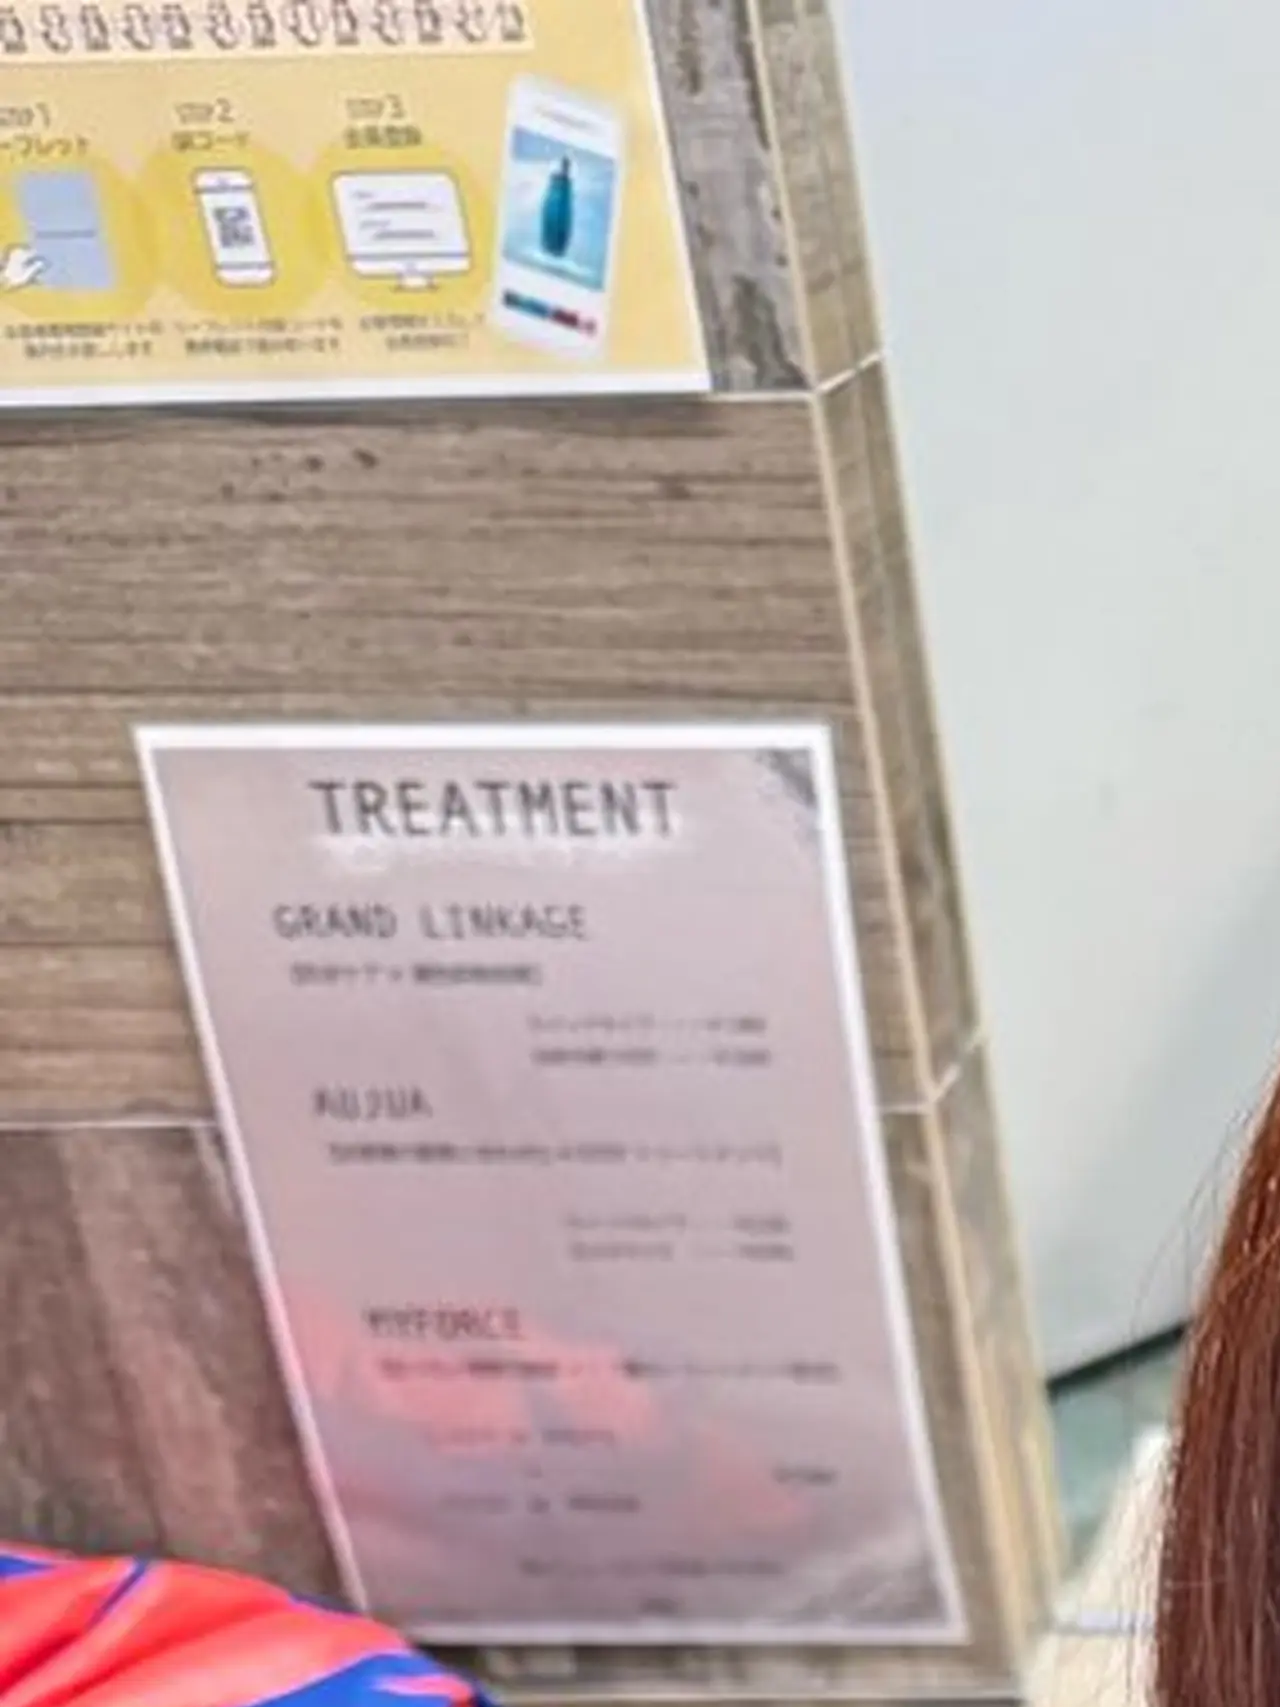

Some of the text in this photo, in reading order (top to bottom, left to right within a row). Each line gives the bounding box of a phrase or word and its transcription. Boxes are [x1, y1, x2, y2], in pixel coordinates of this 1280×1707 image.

[308, 780, 678, 838] TREATMENT
[272, 902, 591, 941] GRAND LINKAGE
